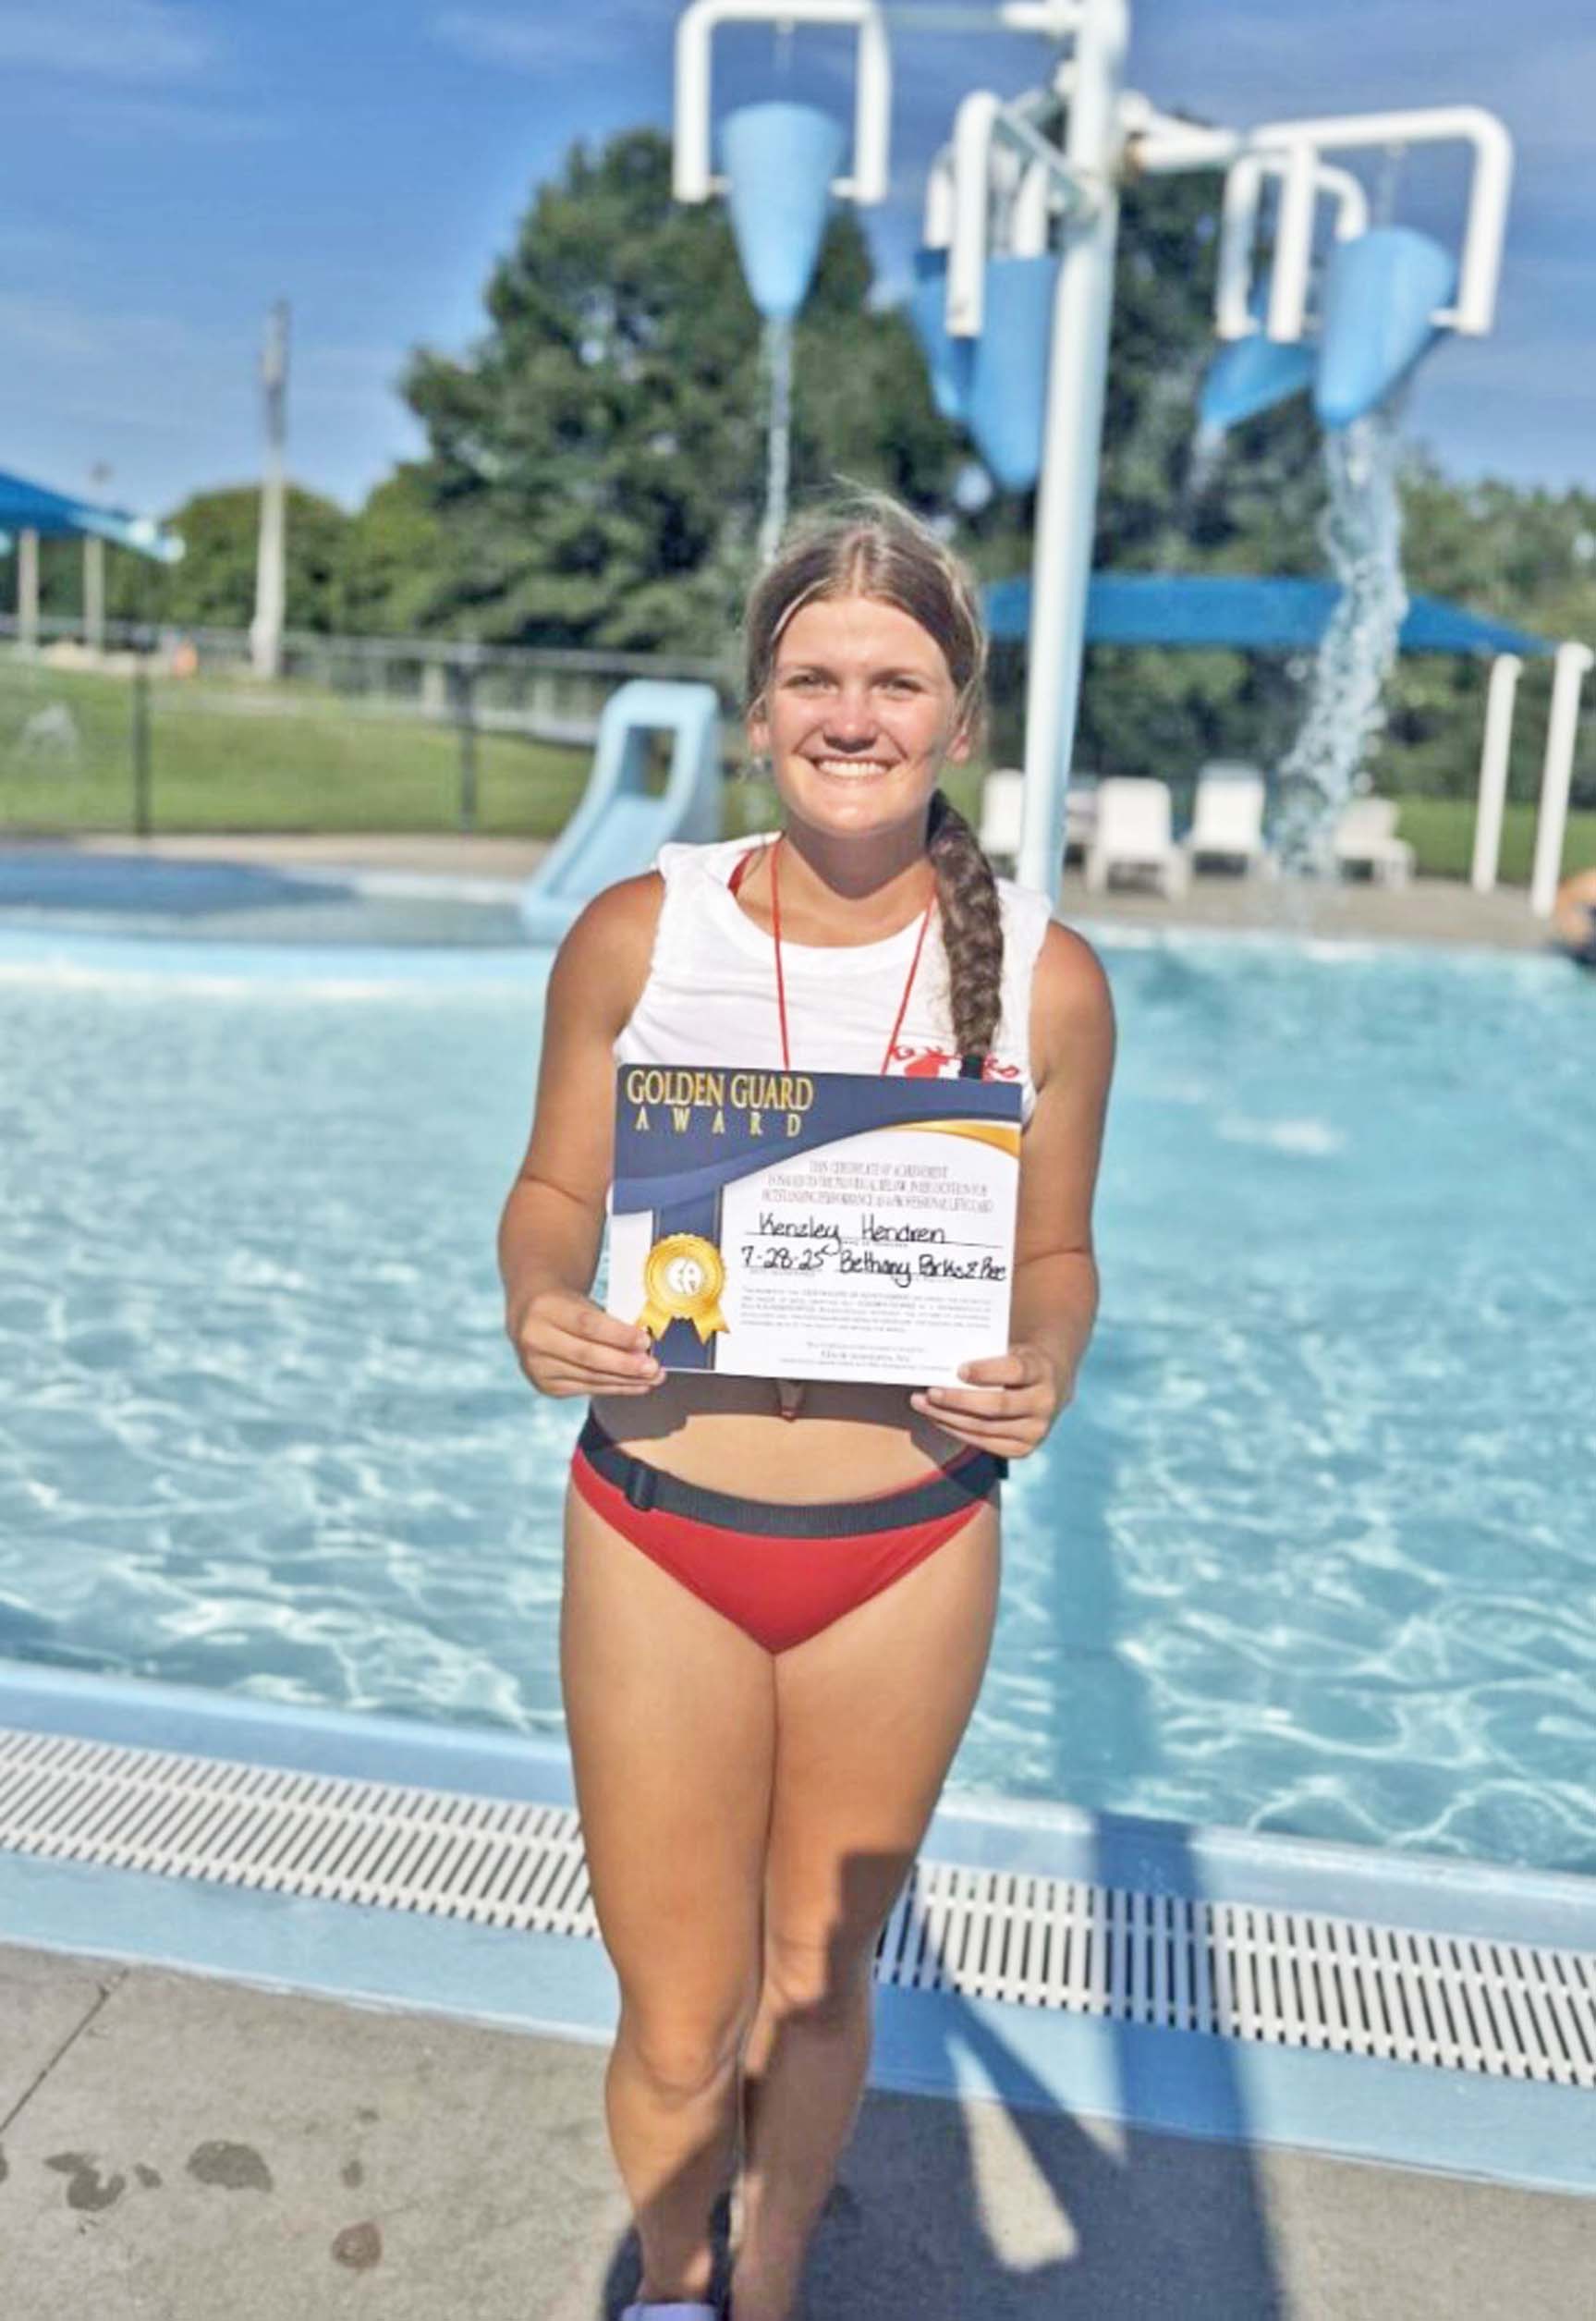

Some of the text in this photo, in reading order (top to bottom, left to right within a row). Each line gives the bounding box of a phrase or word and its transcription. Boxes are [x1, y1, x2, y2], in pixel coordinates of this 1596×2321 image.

[627, 1069, 813, 1111] GOLDEN GUARD
[759, 1213, 945, 1254] Kenzley Hendren
[839, 1250, 912, 1288] Bethany
